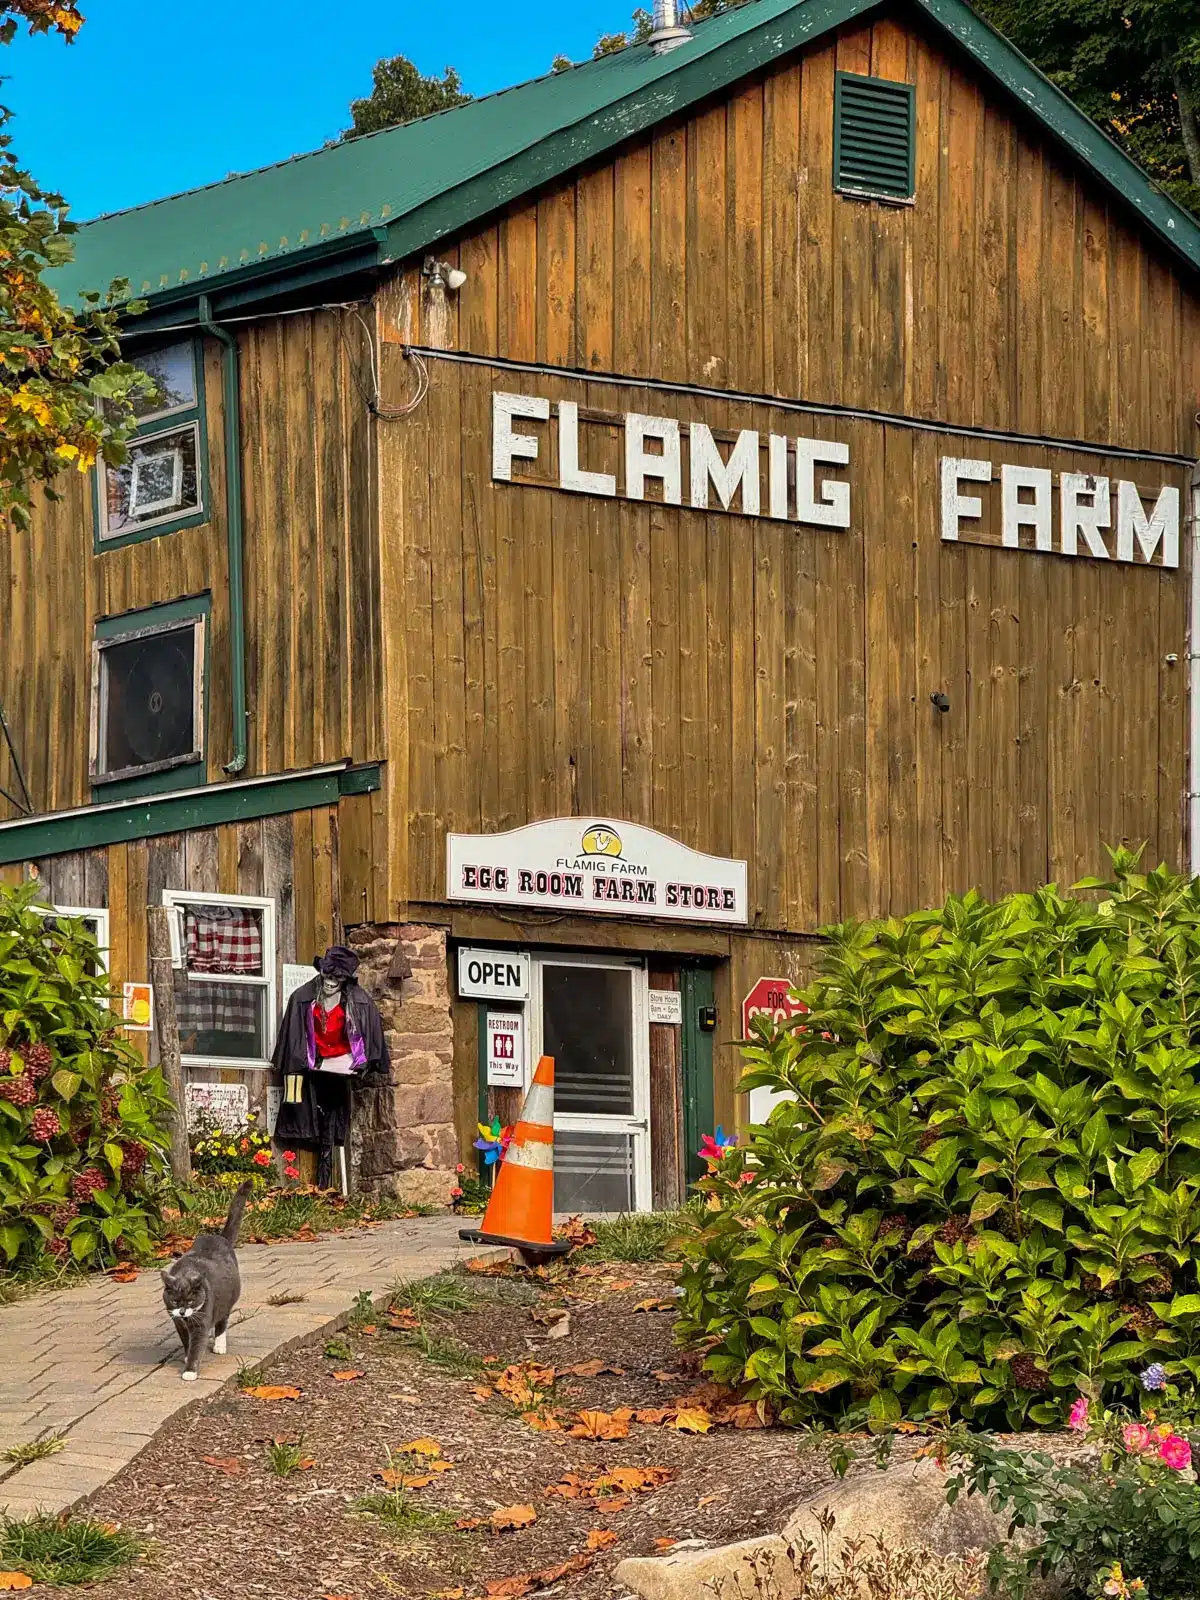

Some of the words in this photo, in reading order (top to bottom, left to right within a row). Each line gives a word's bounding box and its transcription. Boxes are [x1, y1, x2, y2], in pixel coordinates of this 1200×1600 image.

[492, 391, 850, 528] FLAMIG
[941, 456, 1180, 568] FARM
[556, 858, 606, 872] FLAMIG
[611, 863, 648, 876] FARM
[463, 865, 508, 892] EGG
[518, 869, 584, 897] ROOM
[593, 876, 656, 904] FARM
[665, 882, 736, 911] STORE
[468, 961, 521, 987] OPEN
[650, 993, 663, 1002] Store
[664, 995, 679, 1004] Hours
[767, 991, 785, 1009] FOR
[488, 1019, 519, 1031] RESTROOM
[489, 1061, 503, 1069] This
[505, 1062, 519, 1072] Way
